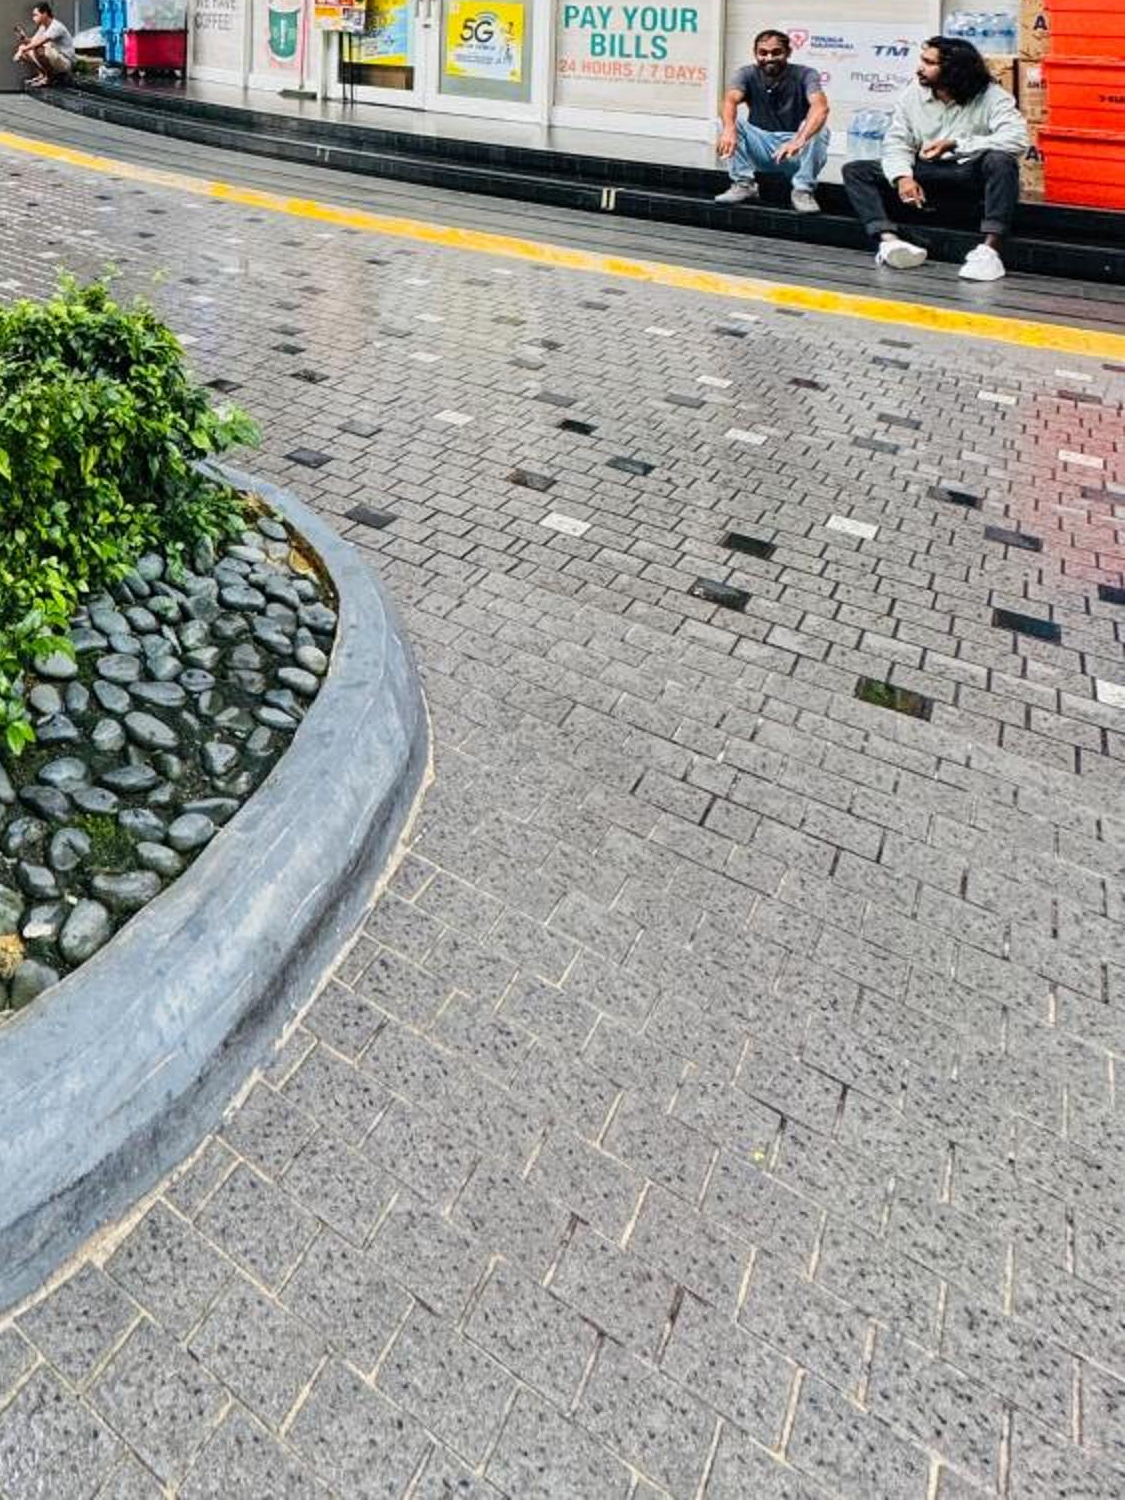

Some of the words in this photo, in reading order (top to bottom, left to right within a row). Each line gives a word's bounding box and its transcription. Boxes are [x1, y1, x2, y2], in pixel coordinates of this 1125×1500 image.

[460, 17, 494, 43] 5G
[564, 4, 612, 29] PAY
[622, 6, 698, 33] YOUR
[590, 33, 668, 60] BILLS
[874, 45, 910, 57] TM
[559, 59, 576, 73] 24
[582, 61, 634, 77] HOURS
[649, 64, 658, 77] 7
[664, 65, 707, 81] DAYS
